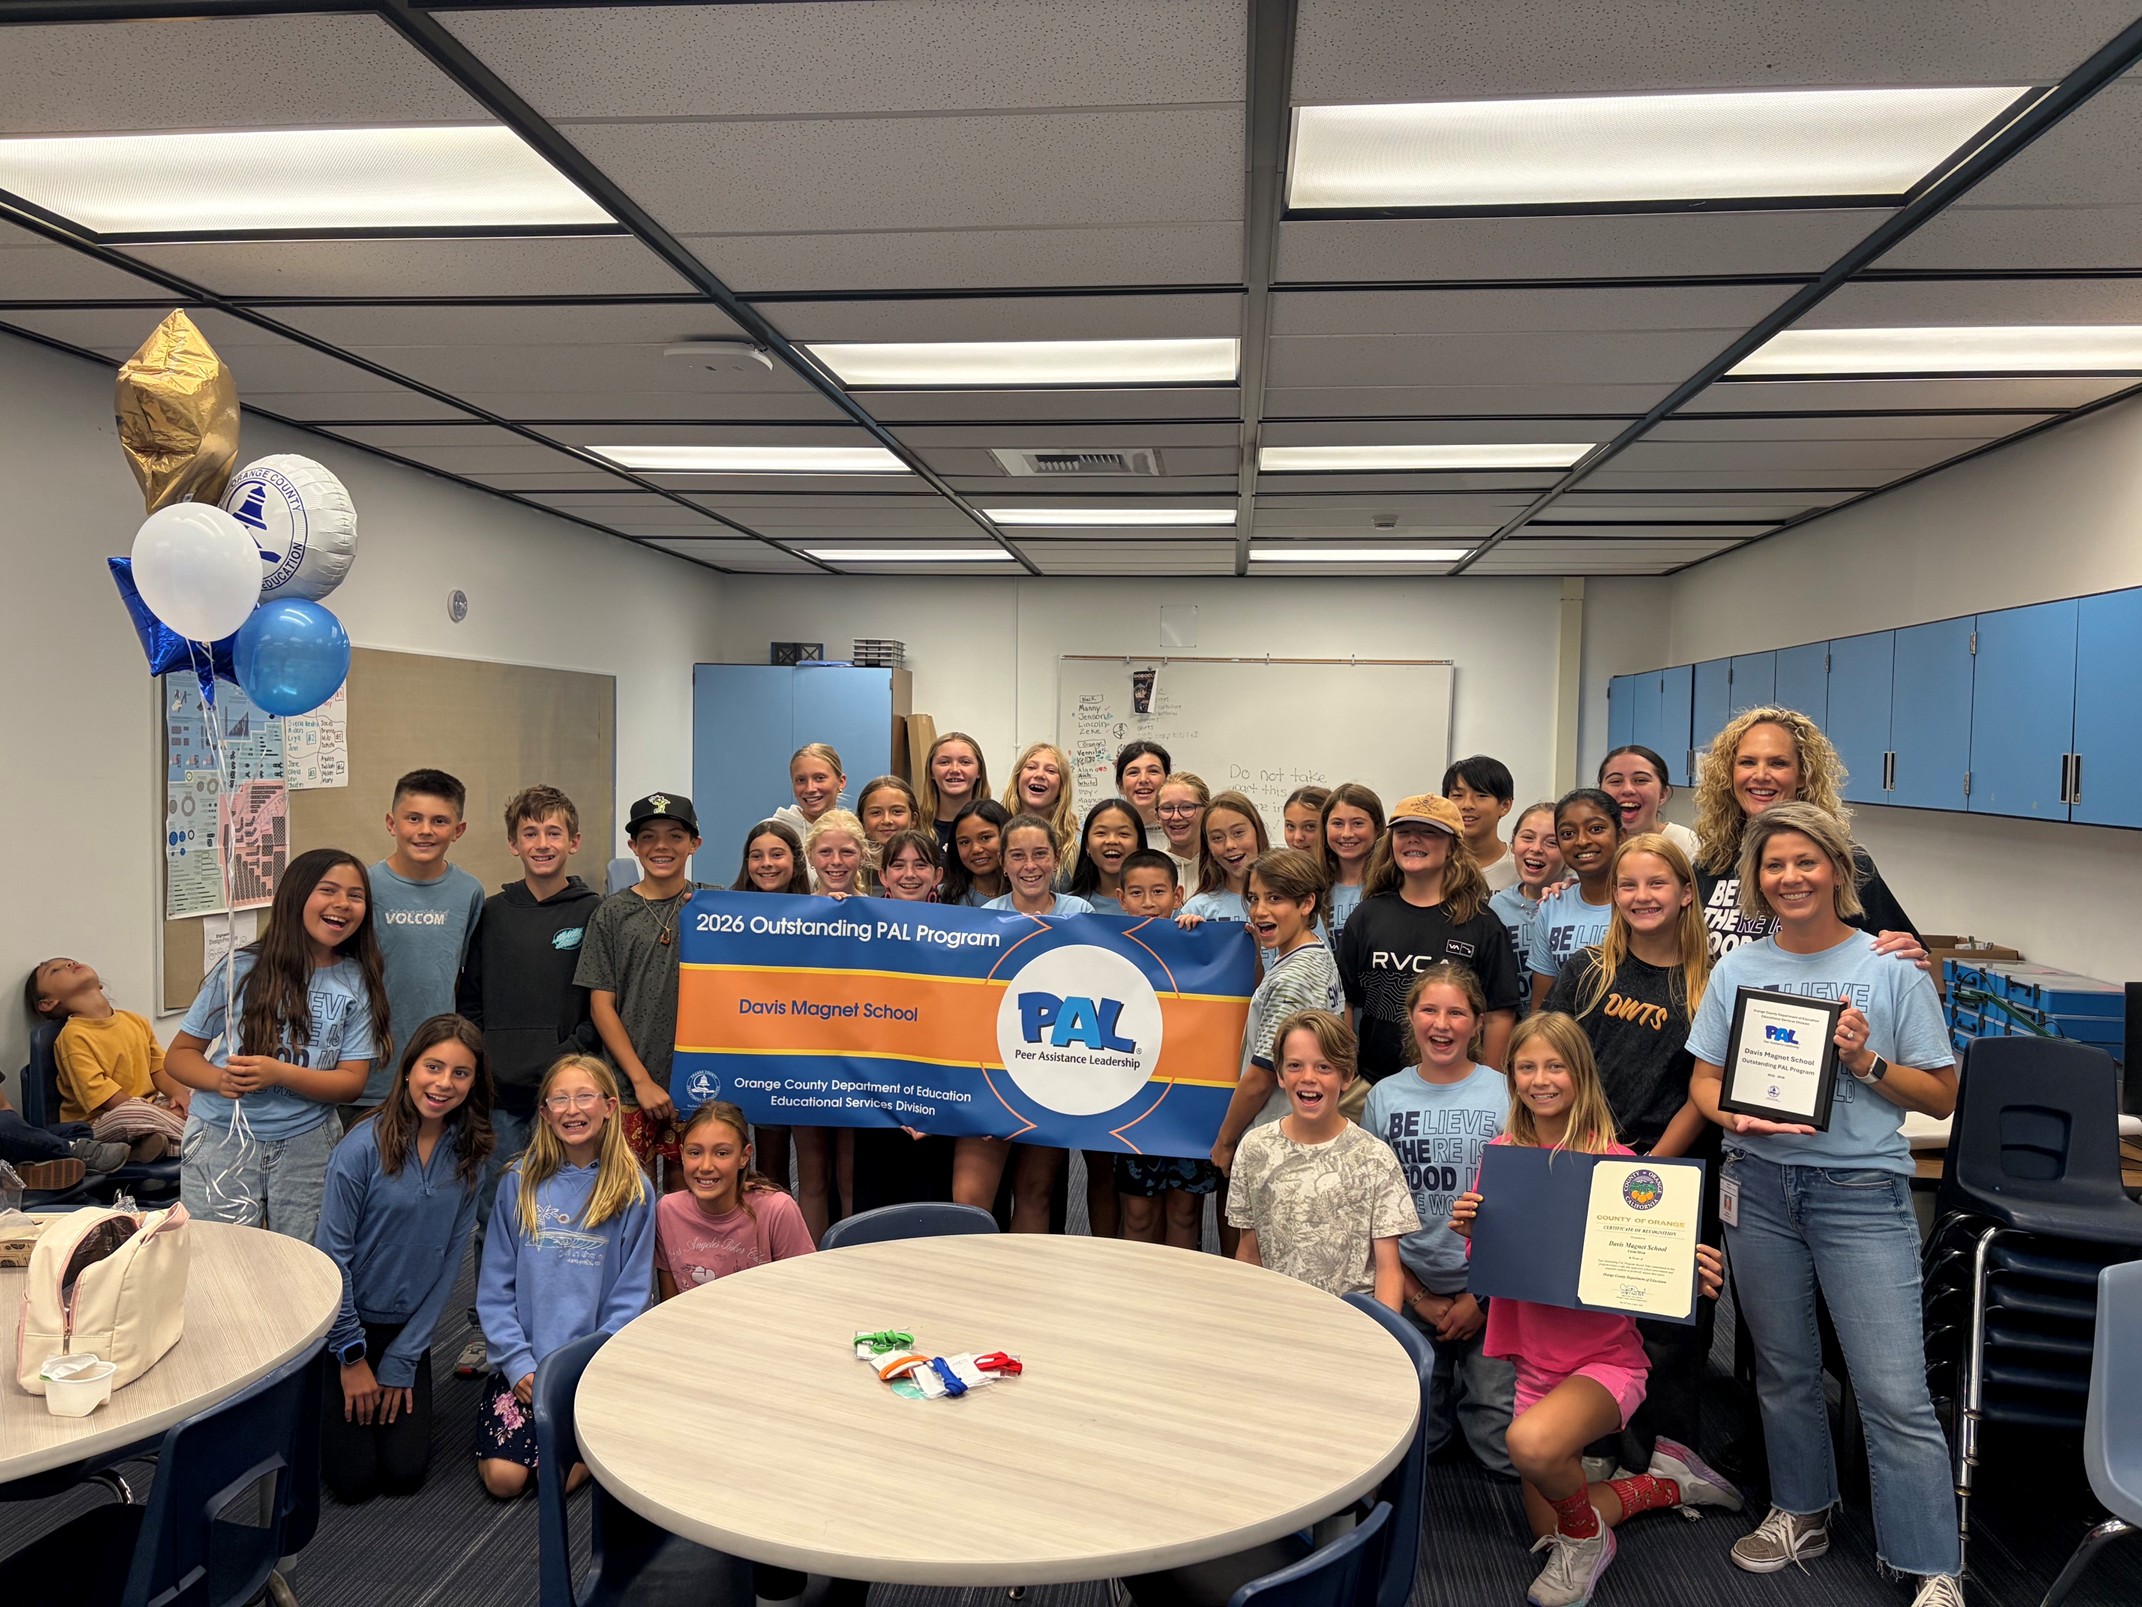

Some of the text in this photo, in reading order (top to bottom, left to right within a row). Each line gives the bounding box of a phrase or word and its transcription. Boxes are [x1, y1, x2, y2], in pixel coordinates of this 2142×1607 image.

[230, 469, 303, 512] ORANGE COUNTY
[1230, 763, 1328, 784] Do not take
[1262, 784, 1287, 797] this
[385, 911, 446, 926] VOLCOM
[696, 914, 1000, 949] 2026 Outstanding PAL Program
[1372, 951, 1450, 973] RVC
[739, 998, 918, 1022] Davis Magnet School
[1604, 993, 1668, 1031] DWTS
[1018, 992, 1137, 1054] PAL
[1765, 1025, 1799, 1045] PAL
[1015, 1049, 1141, 1071] Peer Assistance Leadership
[1742, 1057, 1777, 1069] Outstanding
[1790, 1066, 1815, 1076] Program
[1744, 1048, 1815, 1066] Davis Magnet School
[734, 1077, 972, 1103] Orange County Department of Education
[770, 1095, 936, 1116] Educational Services Division
[1389, 1109, 1496, 1139] BELIEVE
[1392, 1138, 1463, 1164] THERE
[1624, 1171, 1662, 1193] COUNTY ORANGE
[1625, 1195, 1659, 1211] CALIFORNIA
[1596, 1214, 1631, 1222] COUNTY
[1647, 1219, 1686, 1228] ORANGE
[683, 1237, 720, 1252] Angeles
[1625, 1242, 1647, 1250] Magnet
[1647, 1244, 1668, 1252] School
